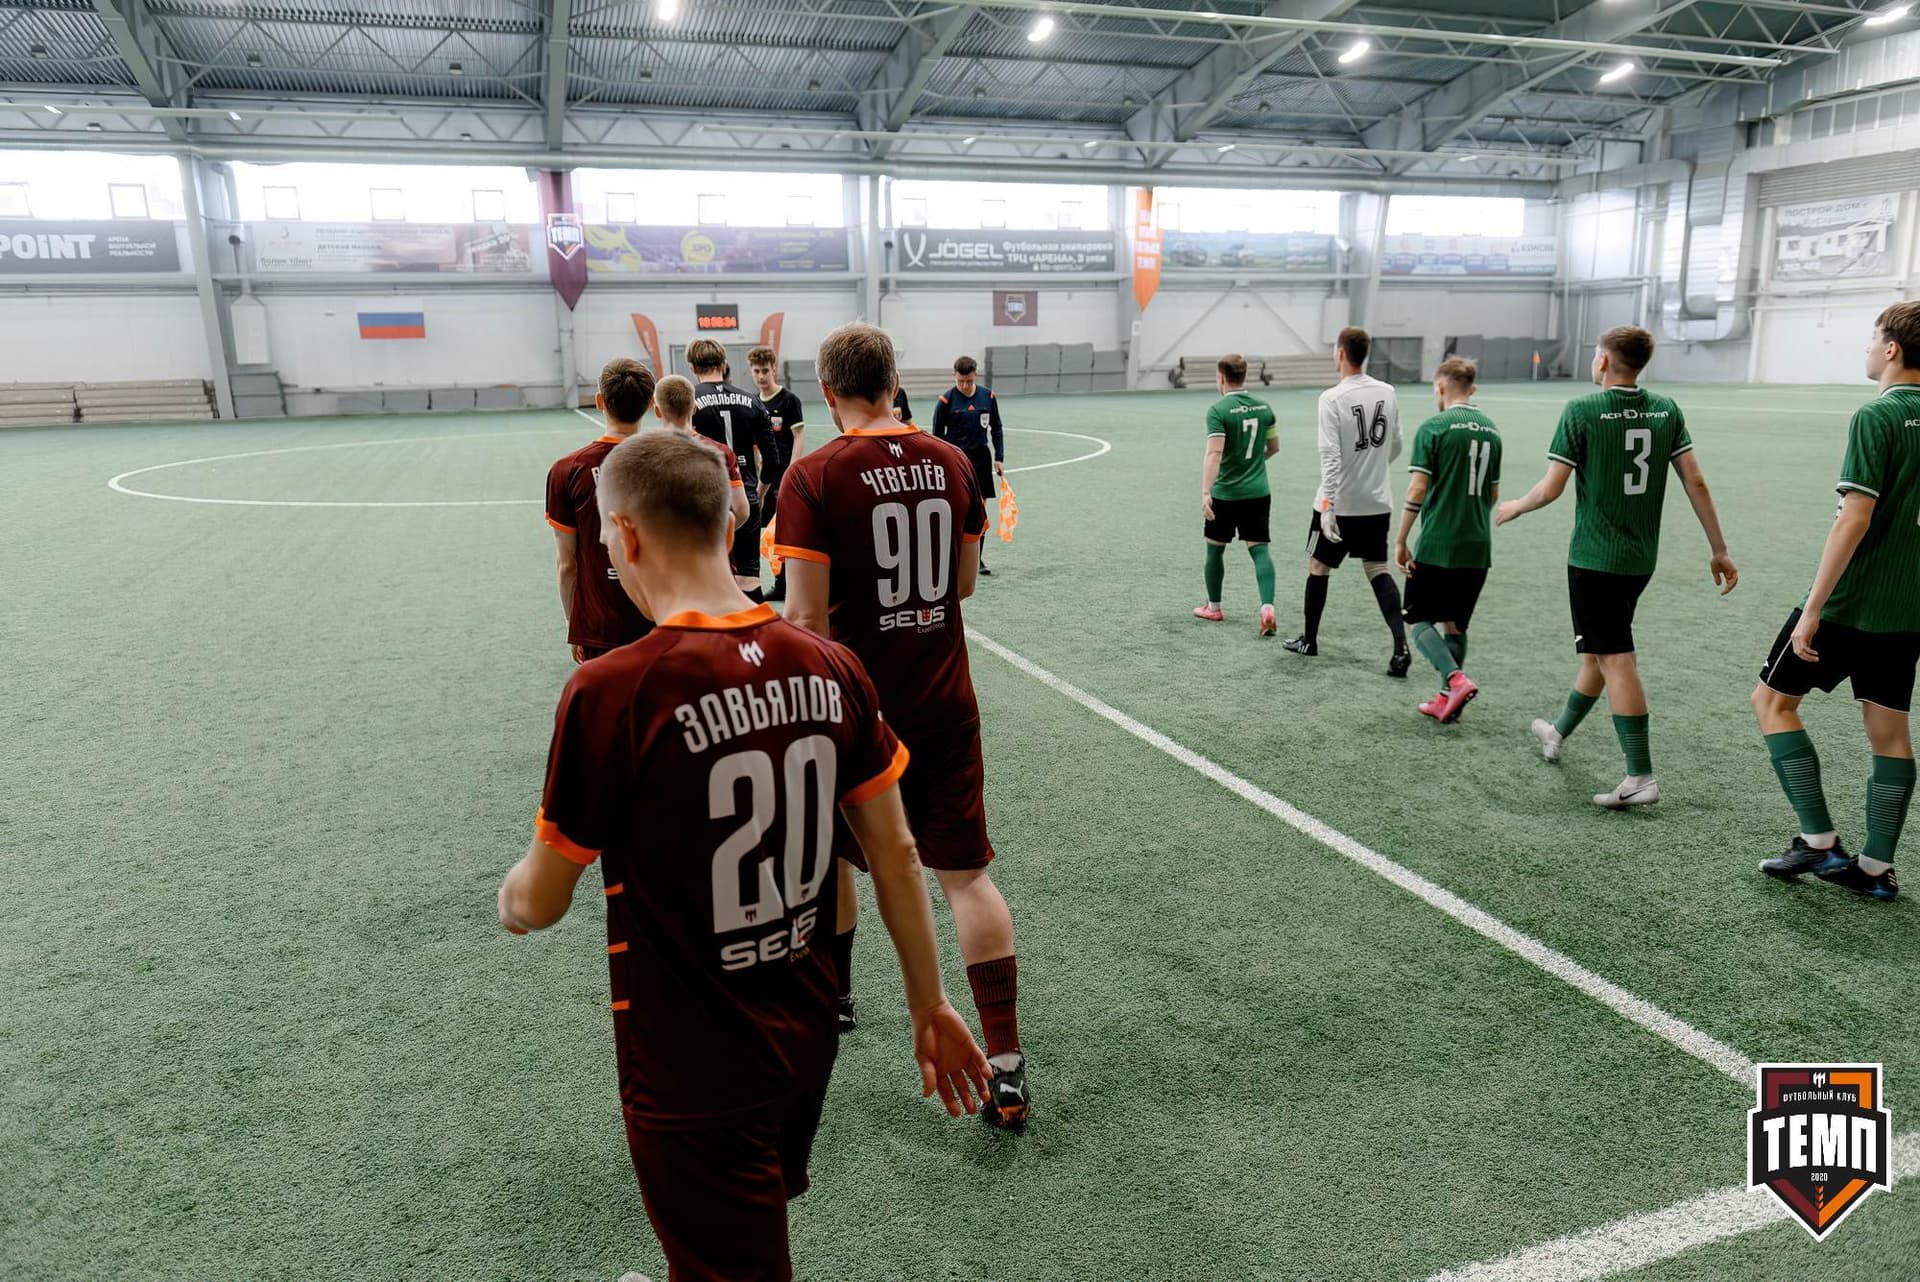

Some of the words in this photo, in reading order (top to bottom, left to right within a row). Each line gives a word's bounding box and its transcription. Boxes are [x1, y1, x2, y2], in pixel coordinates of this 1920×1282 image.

[1007, 253, 1028, 264] ТРЦ
[719, 410, 734, 450] 1
[1242, 417, 1259, 460] 7
[1351, 400, 1387, 452] 16
[860, 459, 946, 496] ЧЕВЕЛЁВ
[1467, 439, 1491, 497] 11
[1623, 428, 1652, 496] 3
[872, 498, 952, 608] 90
[879, 606, 946, 631] SEUS
[674, 675, 844, 754] ЗАВЬЯЛОВ
[707, 734, 838, 934] 20
